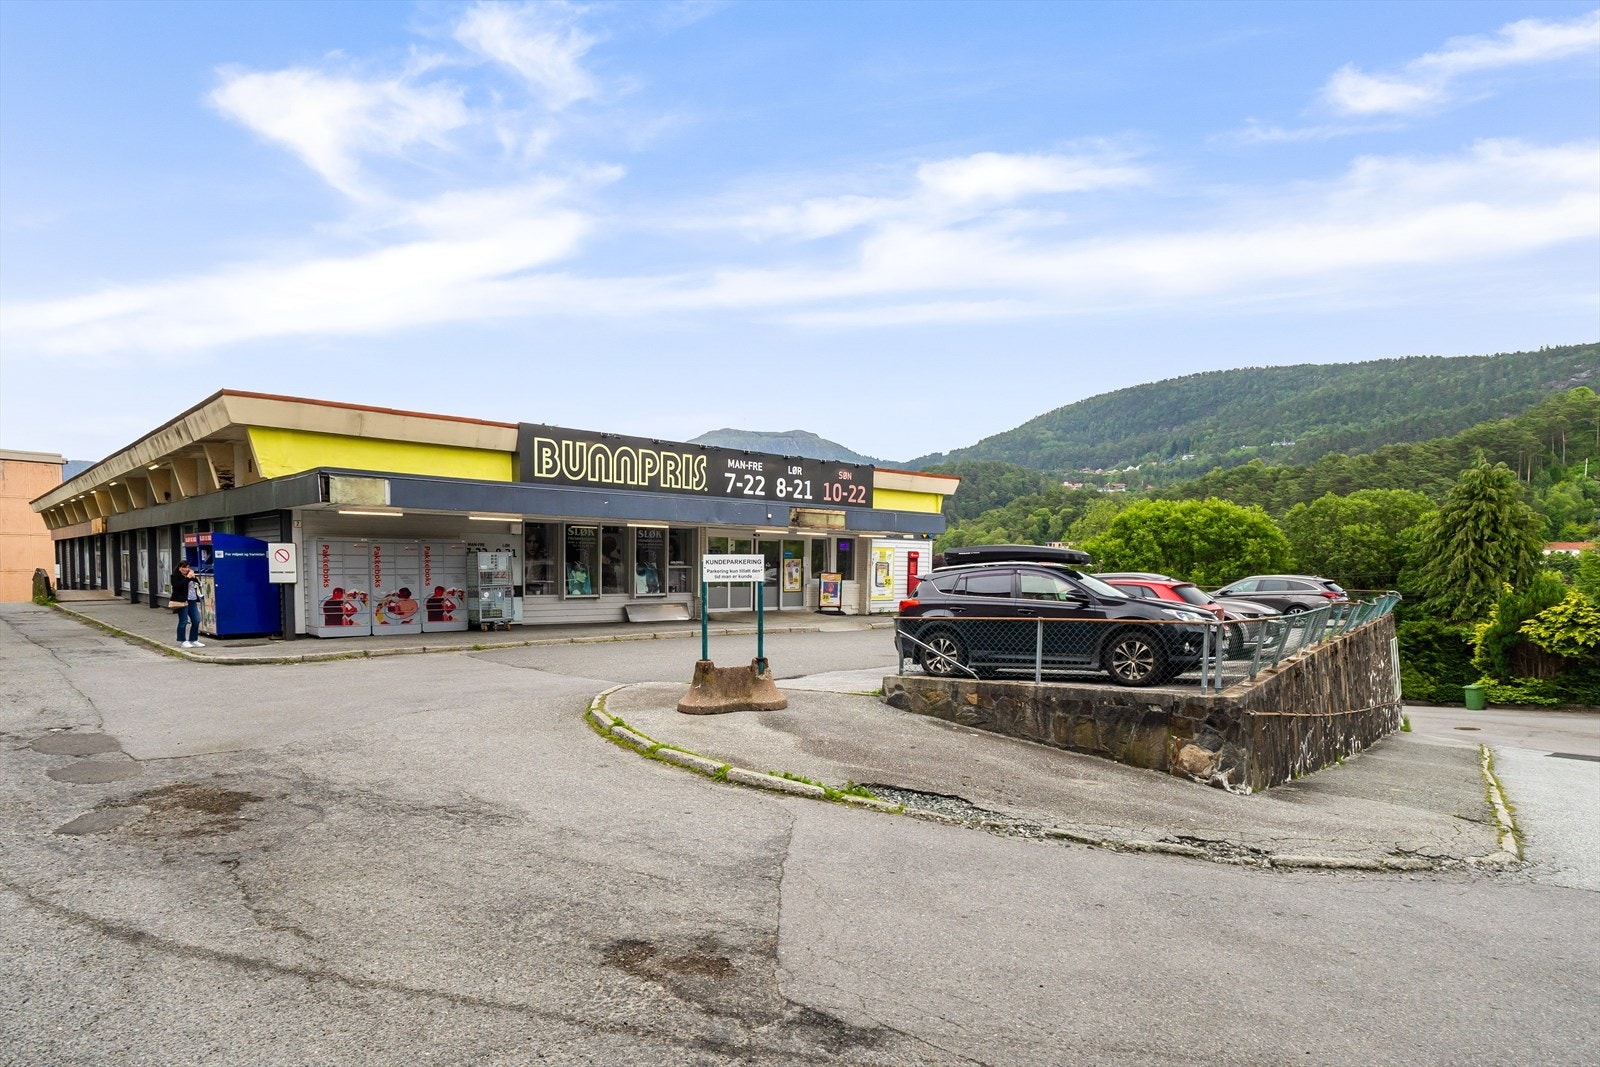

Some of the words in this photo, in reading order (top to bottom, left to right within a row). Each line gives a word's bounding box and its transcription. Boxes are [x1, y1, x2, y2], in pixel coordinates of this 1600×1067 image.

[727, 459, 763, 472] MAN-FRE
[788, 465, 803, 476] LØR
[838, 471, 852, 480] SØN
[724, 472, 766, 496] 7-22
[776, 477, 813, 500] 8-21
[823, 482, 866, 504] 10-22
[567, 527, 595, 537] SLØK
[638, 530, 662, 539] SLØK
[322, 544, 330, 588] Pakkeboks
[373, 546, 382, 588] Pakkeboks
